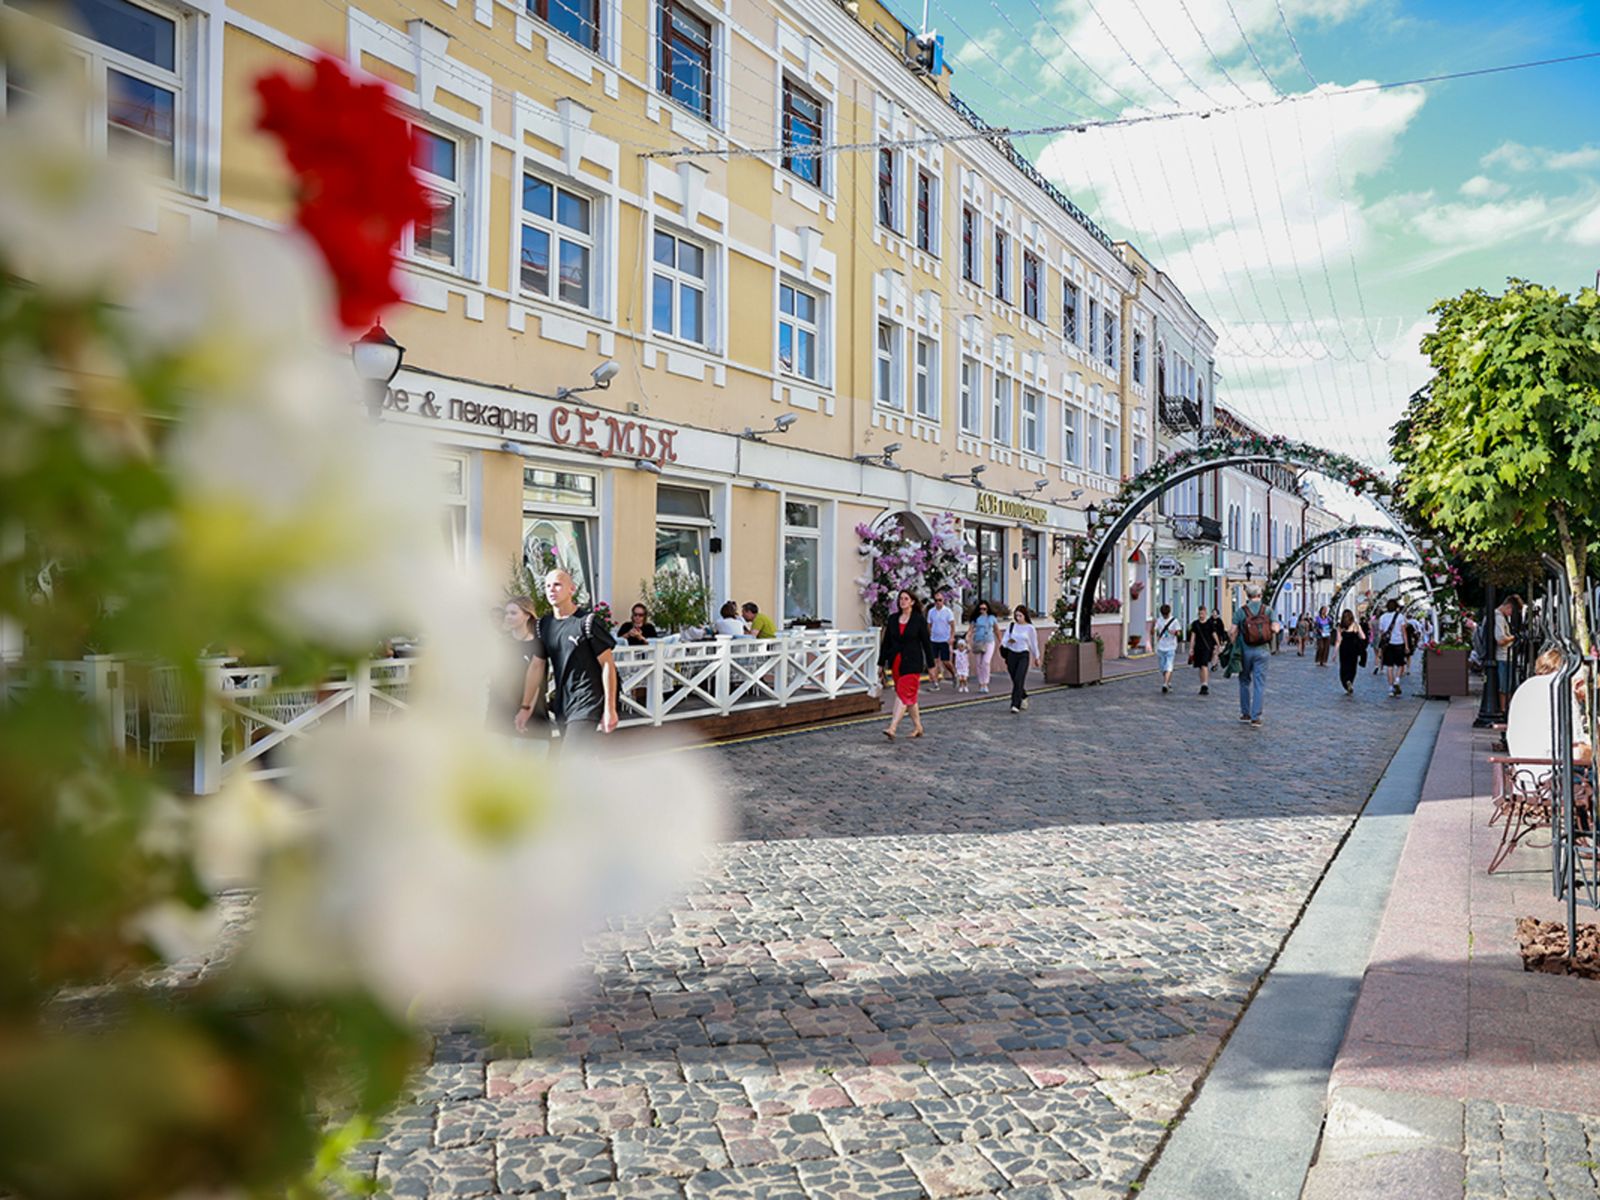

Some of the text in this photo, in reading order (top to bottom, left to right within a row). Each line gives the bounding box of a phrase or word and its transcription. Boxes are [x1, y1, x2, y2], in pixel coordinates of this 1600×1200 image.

[419, 391, 442, 419] &
[449, 398, 538, 434] пекарня
[550, 406, 678, 468] СЕМЬЯ
